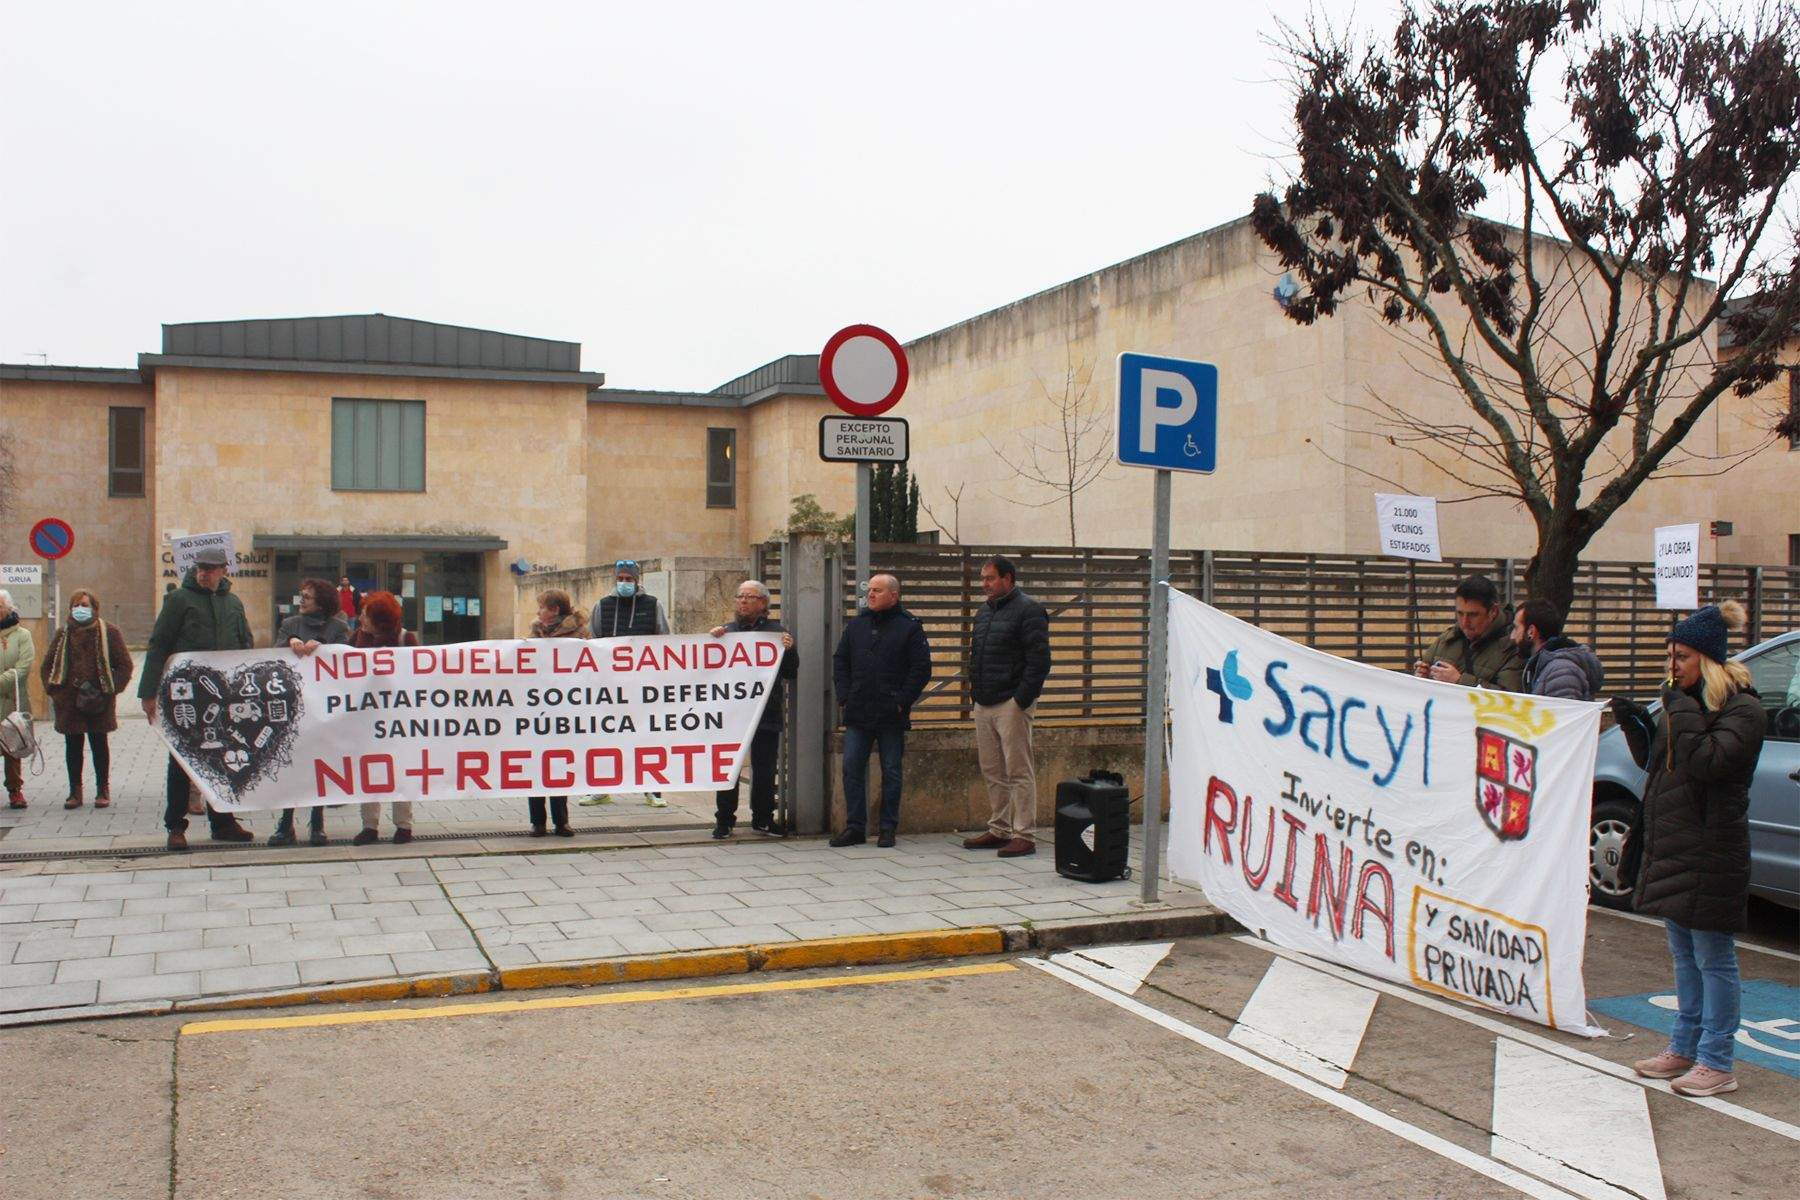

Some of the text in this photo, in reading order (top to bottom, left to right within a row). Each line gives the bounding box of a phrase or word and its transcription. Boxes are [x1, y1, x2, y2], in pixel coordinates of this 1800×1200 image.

[1138, 367, 1198, 453] P
[840, 423, 890, 433] EXCEPTO
[837, 446, 894, 456] SANITARIO
[1394, 507, 1418, 518] 21.000
[181, 537, 224, 548] NO SOMOS
[1392, 524, 1423, 535] VECINOS
[235, 552, 269, 564] Salud
[1389, 540, 1431, 553] ESTAFADOS
[1665, 543, 1672, 555] LA
[1674, 541, 1692, 554] OBRA
[315, 641, 778, 682] NOS DUELE LA SANIDAD
[327, 681, 765, 714] PLATAFORMA SOCIAL DEFENSA
[374, 707, 724, 739] SANIDAD PÚBLICA LEÓN
[1263, 661, 1434, 787] Sacyl
[1281, 770, 1394, 859] Invierte
[1204, 775, 1396, 963] RUINA
[1448, 915, 1542, 964] SANIDAD
[1424, 944, 1538, 1013] PRIVADA
